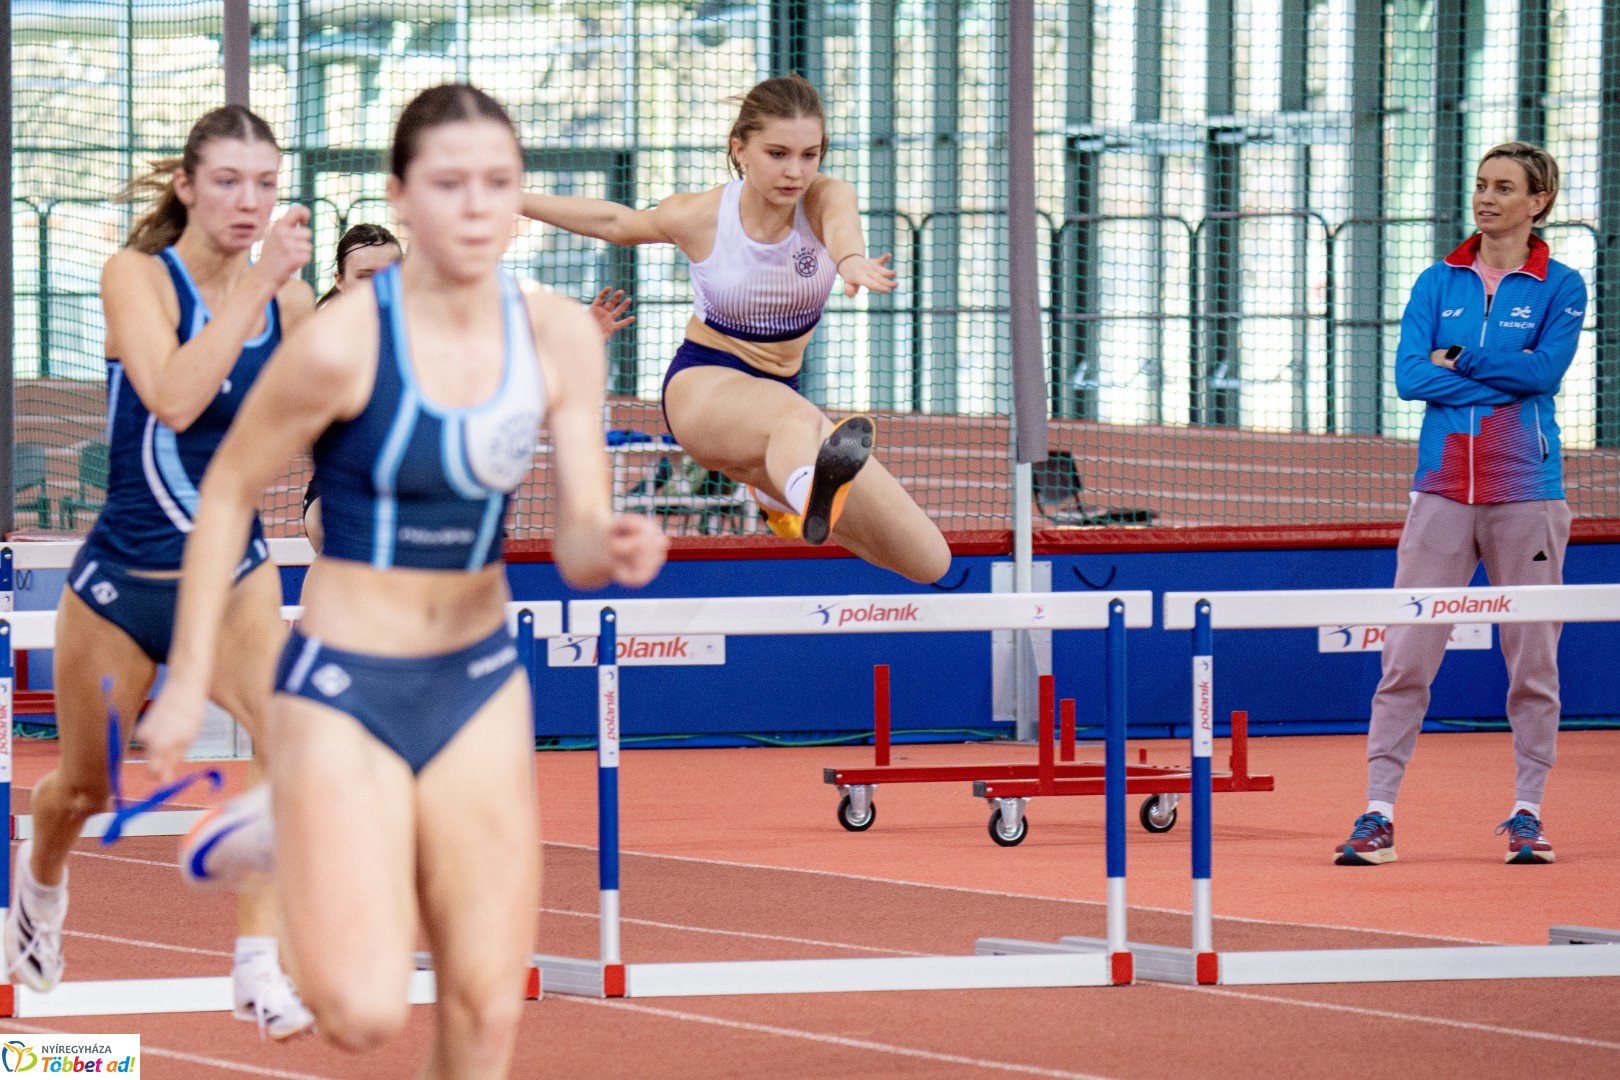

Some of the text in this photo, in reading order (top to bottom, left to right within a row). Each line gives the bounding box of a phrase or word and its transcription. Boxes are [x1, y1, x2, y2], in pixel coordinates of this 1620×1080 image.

[838, 602, 919, 627] polanik
[1431, 594, 1512, 618] polanik
[604, 690, 616, 740] polanik
[1199, 680, 1210, 730] polanik
